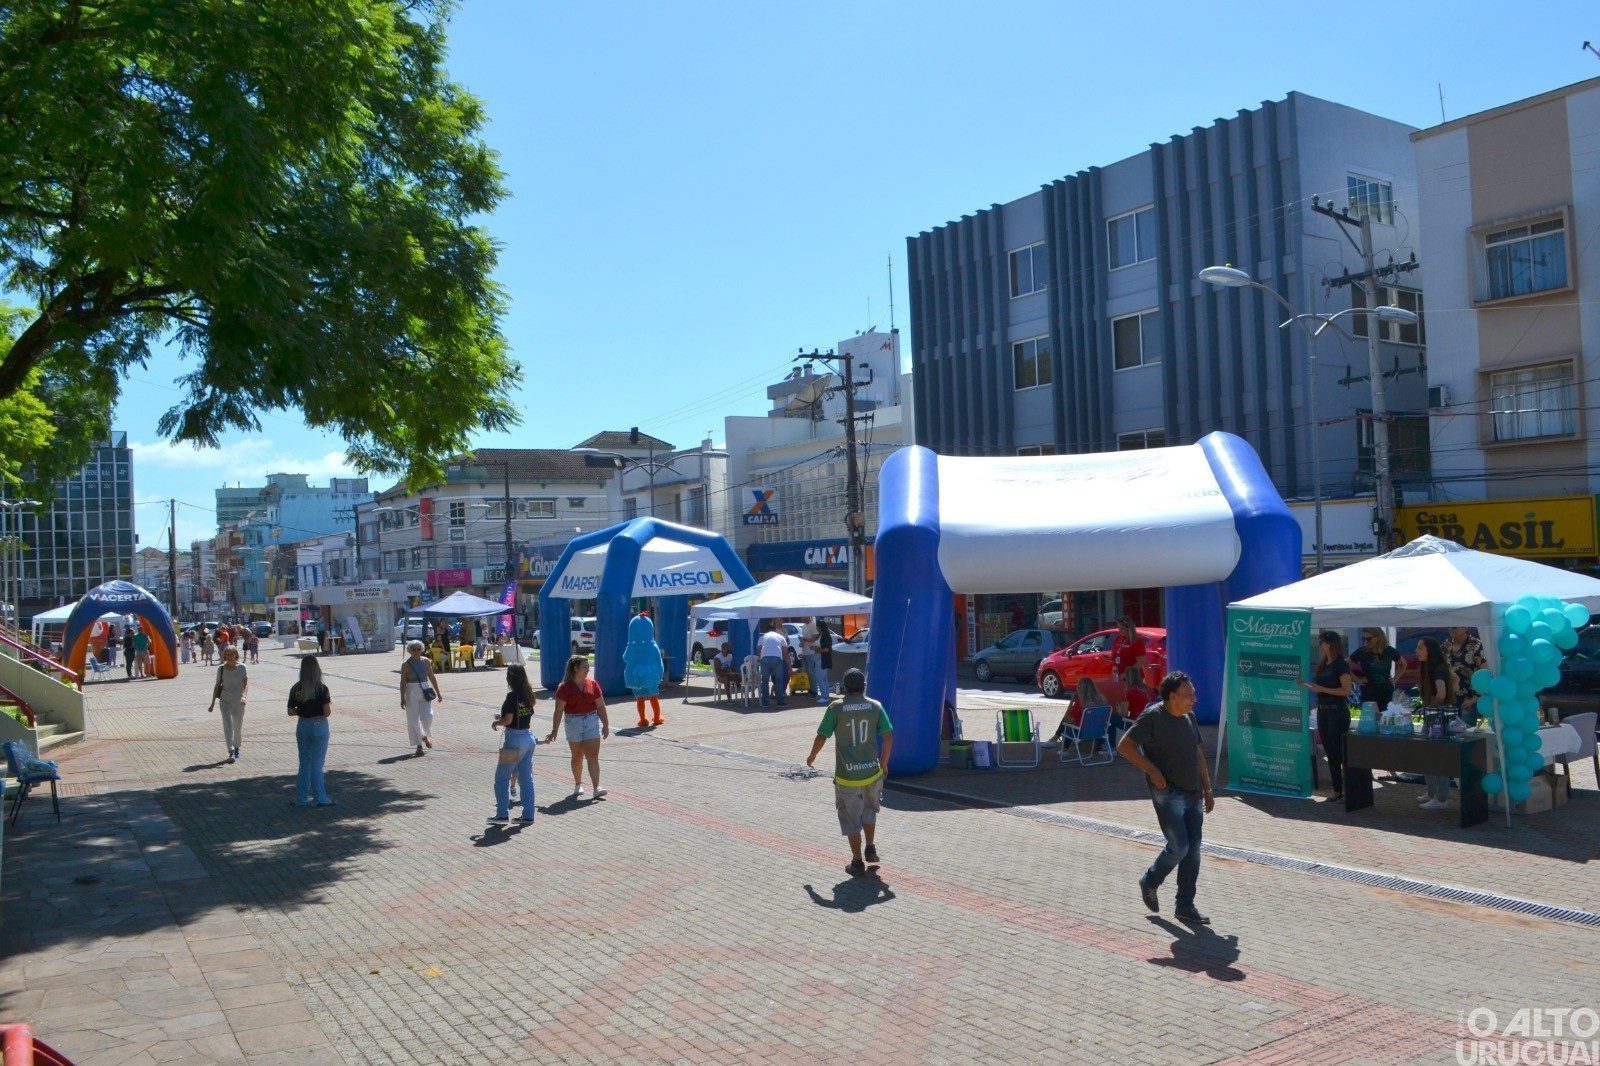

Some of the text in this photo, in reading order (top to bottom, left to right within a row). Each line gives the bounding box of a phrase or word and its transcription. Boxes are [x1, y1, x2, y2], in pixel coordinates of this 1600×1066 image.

[747, 515, 777, 524] CAIXA
[1415, 511, 1458, 525] Casa
[804, 545, 848, 565] CAIXA
[562, 575, 599, 590] MARSO
[640, 570, 724, 588] MARSOL
[1260, 661, 1300, 669] Emagrecimento
[846, 718, 868, 747] 10
[1252, 761, 1290, 772] redes sociais
